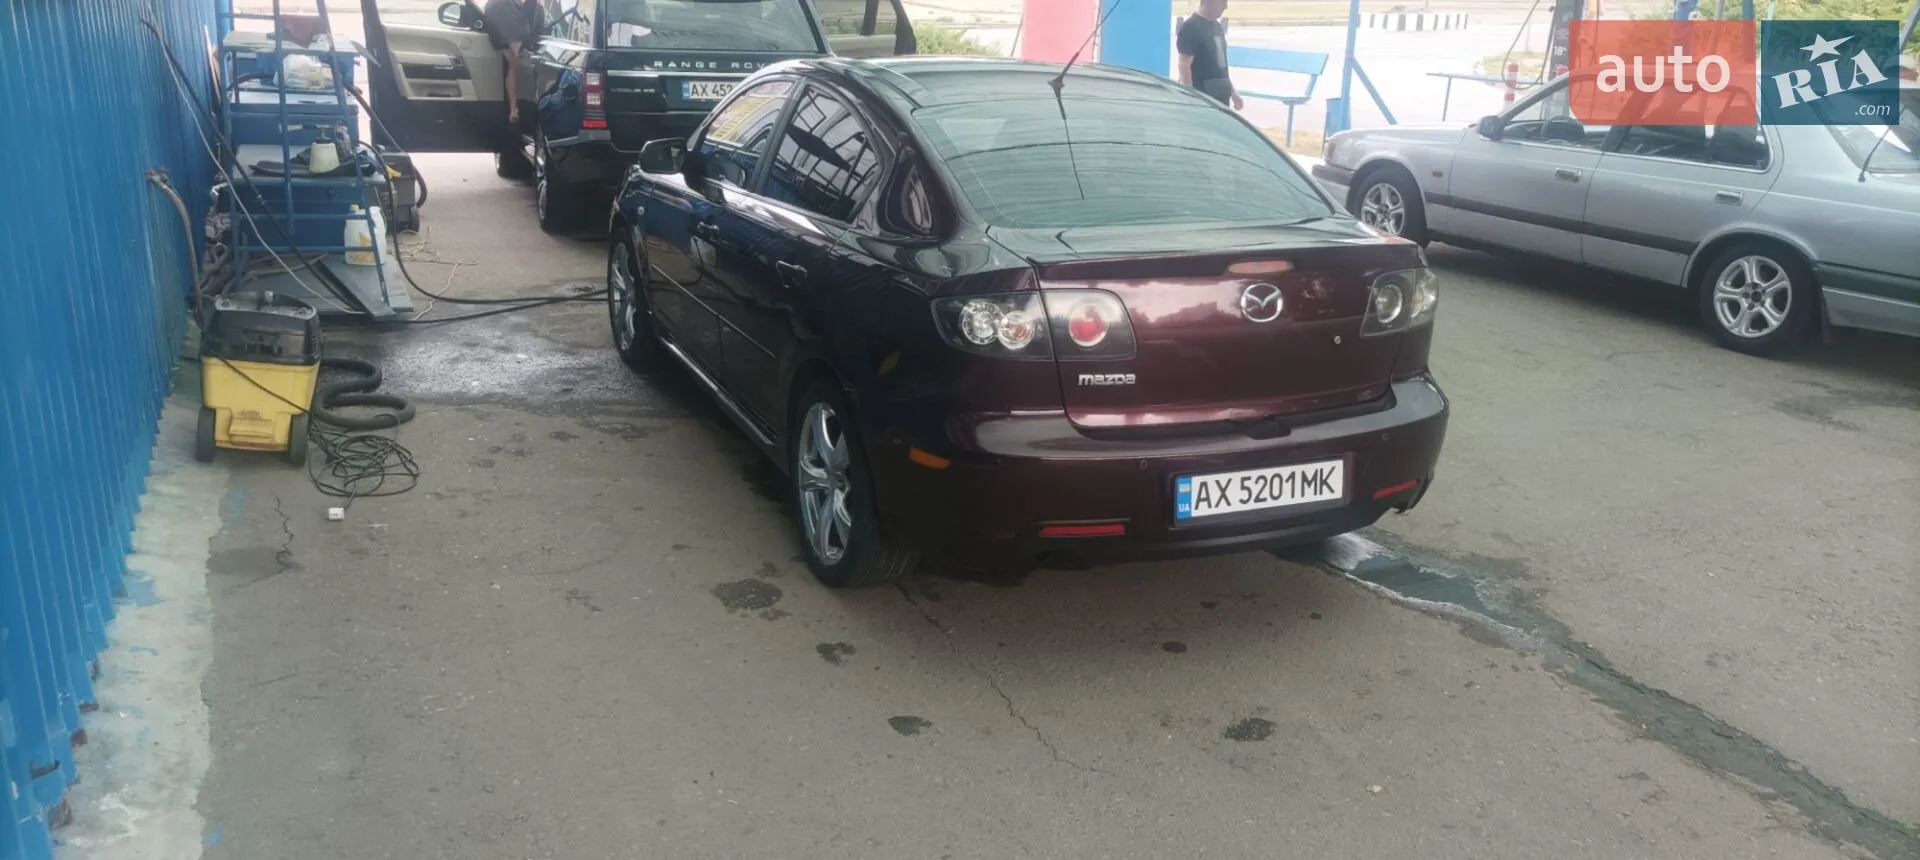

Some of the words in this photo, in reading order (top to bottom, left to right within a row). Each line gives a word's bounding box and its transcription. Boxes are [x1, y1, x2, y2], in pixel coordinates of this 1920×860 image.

[654, 61, 717, 69] RANGE
[690, 83, 709, 97] AX
[1078, 373, 1136, 386] mazda
[1194, 478, 1231, 510] AX
[1178, 503, 1190, 513] UA
